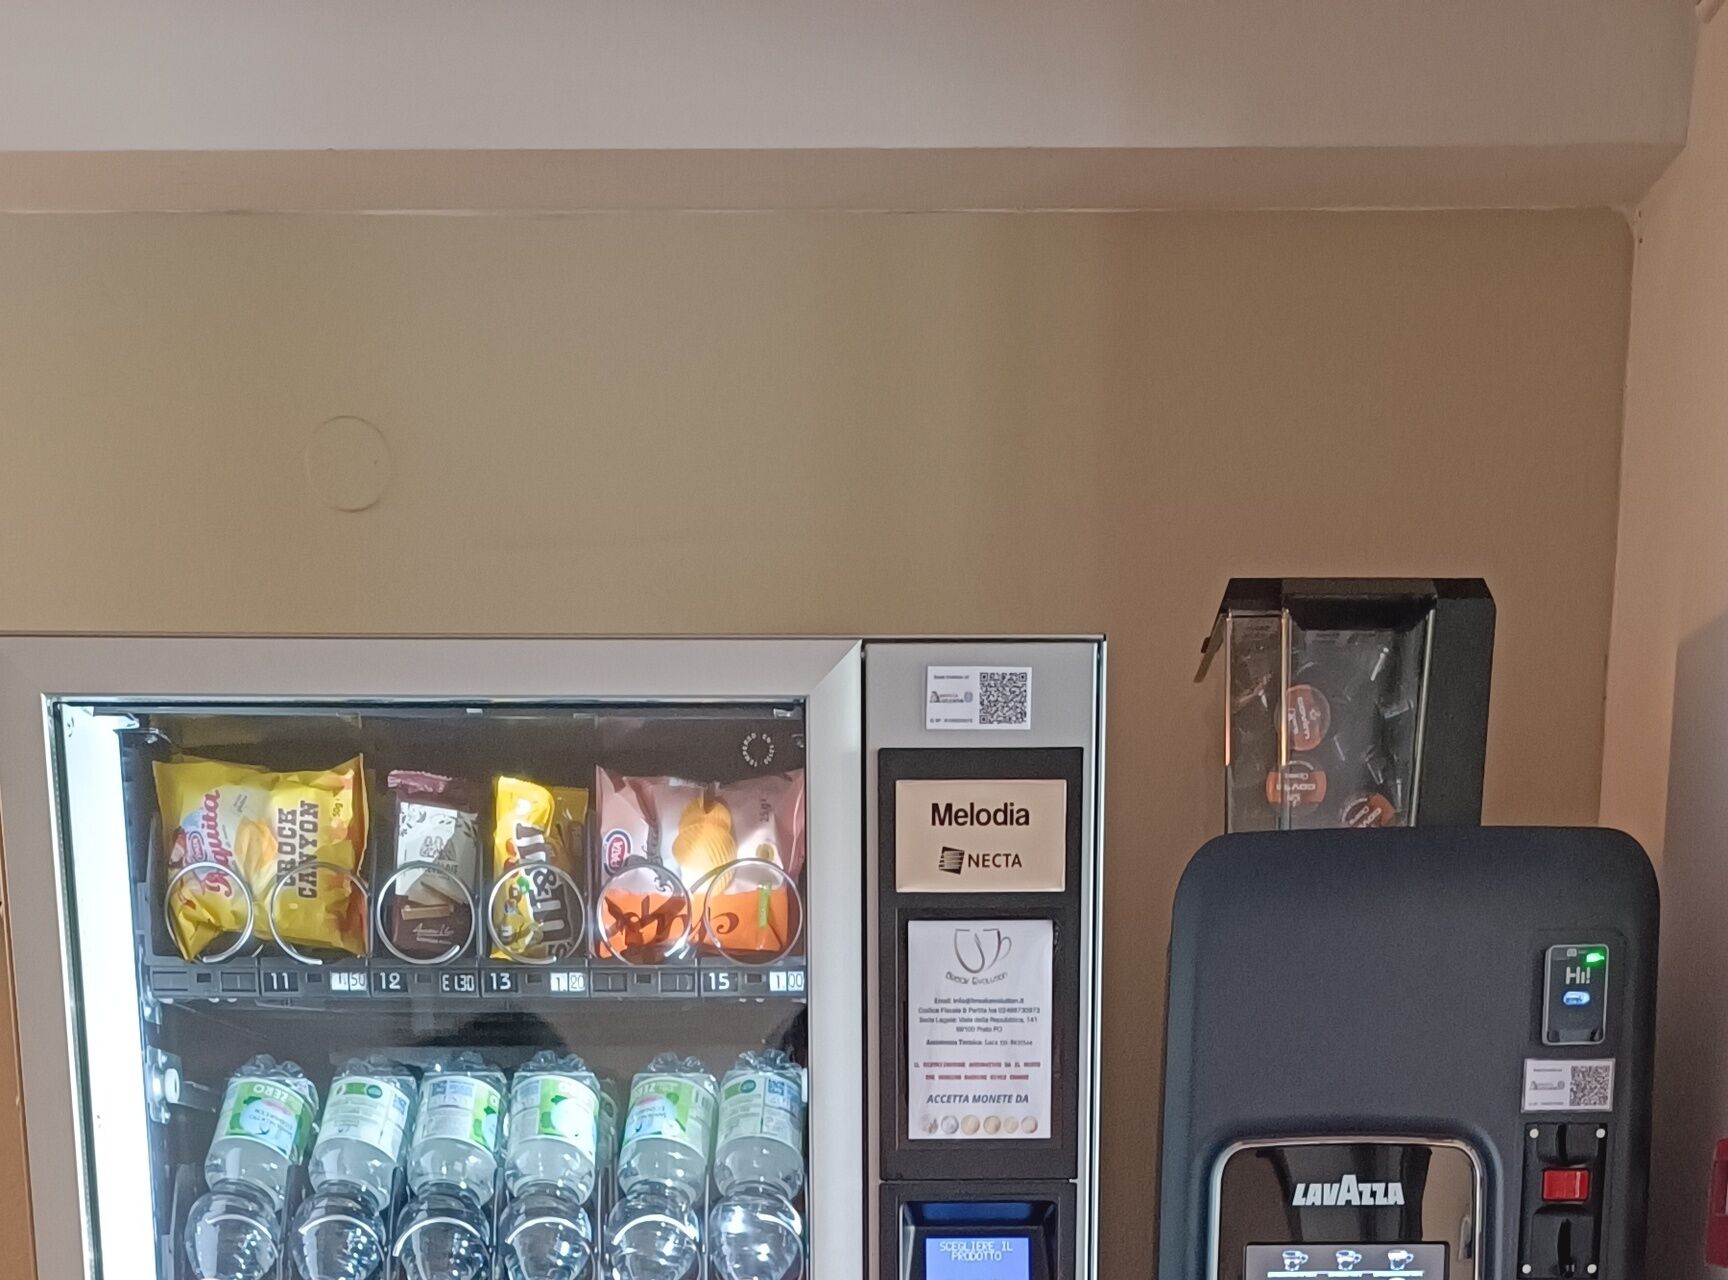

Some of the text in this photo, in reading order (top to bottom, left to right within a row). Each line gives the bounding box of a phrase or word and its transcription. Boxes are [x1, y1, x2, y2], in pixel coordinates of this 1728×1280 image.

[931, 802, 1030, 826] Melodia
[968, 853, 1022, 868] NECTA
[271, 973, 290, 990] 11
[380, 973, 401, 990] 12
[490, 973, 511, 990] 13
[709, 973, 730, 990] 15
[1566, 966, 1591, 984] Hi!
[253, 1084, 289, 1103] ZERO
[926, 1094, 1029, 1104] ACCETTA MONETE DA
[1292, 1174, 1405, 1206] LAVAZZA
[939, 1240, 1013, 1252] SCEGLIERE IL
[951, 1251, 1002, 1261] PRODOTTO
